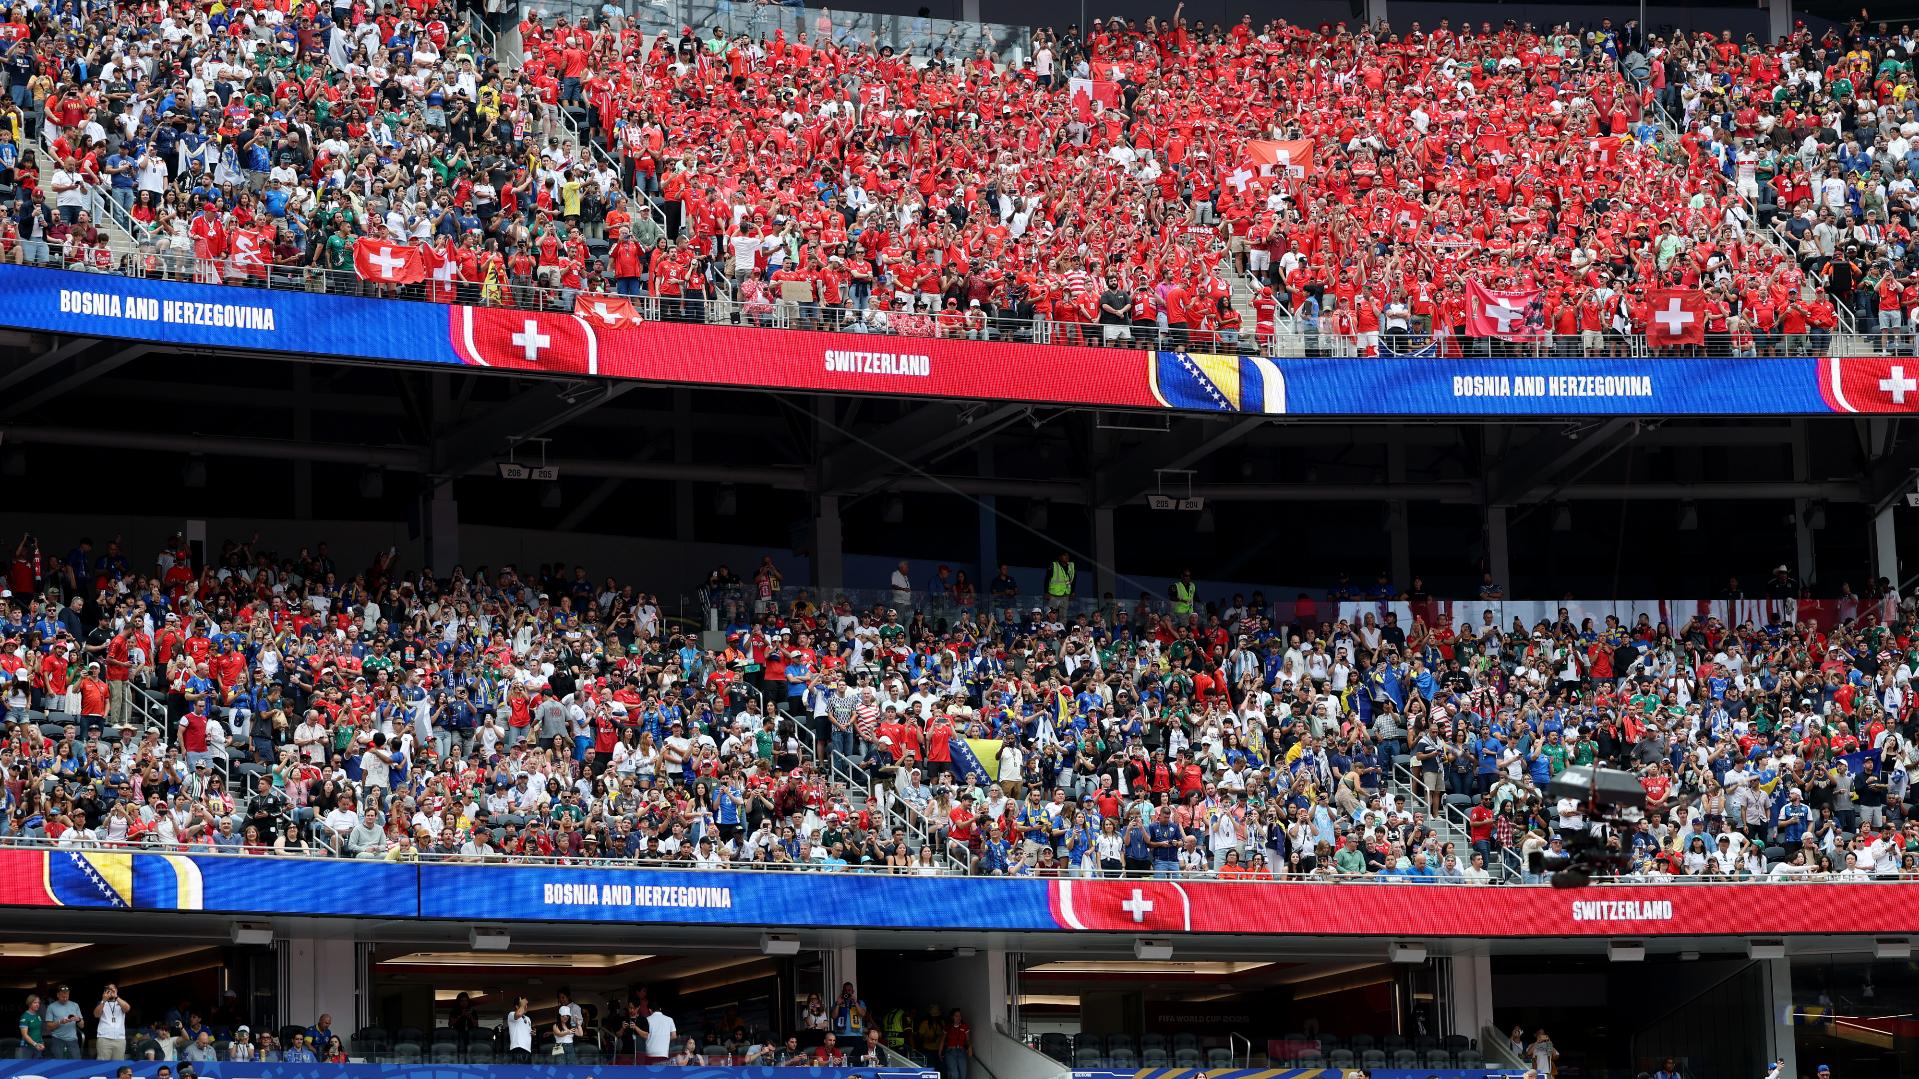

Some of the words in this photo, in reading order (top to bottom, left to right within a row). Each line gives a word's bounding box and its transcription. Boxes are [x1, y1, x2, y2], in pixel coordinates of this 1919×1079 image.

[1187, 226, 1214, 235] SUISSE
[60, 289, 121, 317] BOSNIA
[125, 296, 158, 321] AND
[164, 300, 274, 331] HERZEGOVINA
[824, 350, 930, 376] SWITZERLAND
[1453, 376, 1511, 397] BOSNIA
[1514, 376, 1546, 397] AND
[1549, 376, 1653, 397] HERZEGOVINA
[544, 884, 599, 905] BOSNIA
[602, 885, 632, 906] AND
[635, 885, 731, 908] HERZEGOVINA
[1572, 900, 1673, 921] SWITZERLAND
[1176, 1015, 1205, 1023] WORLD
